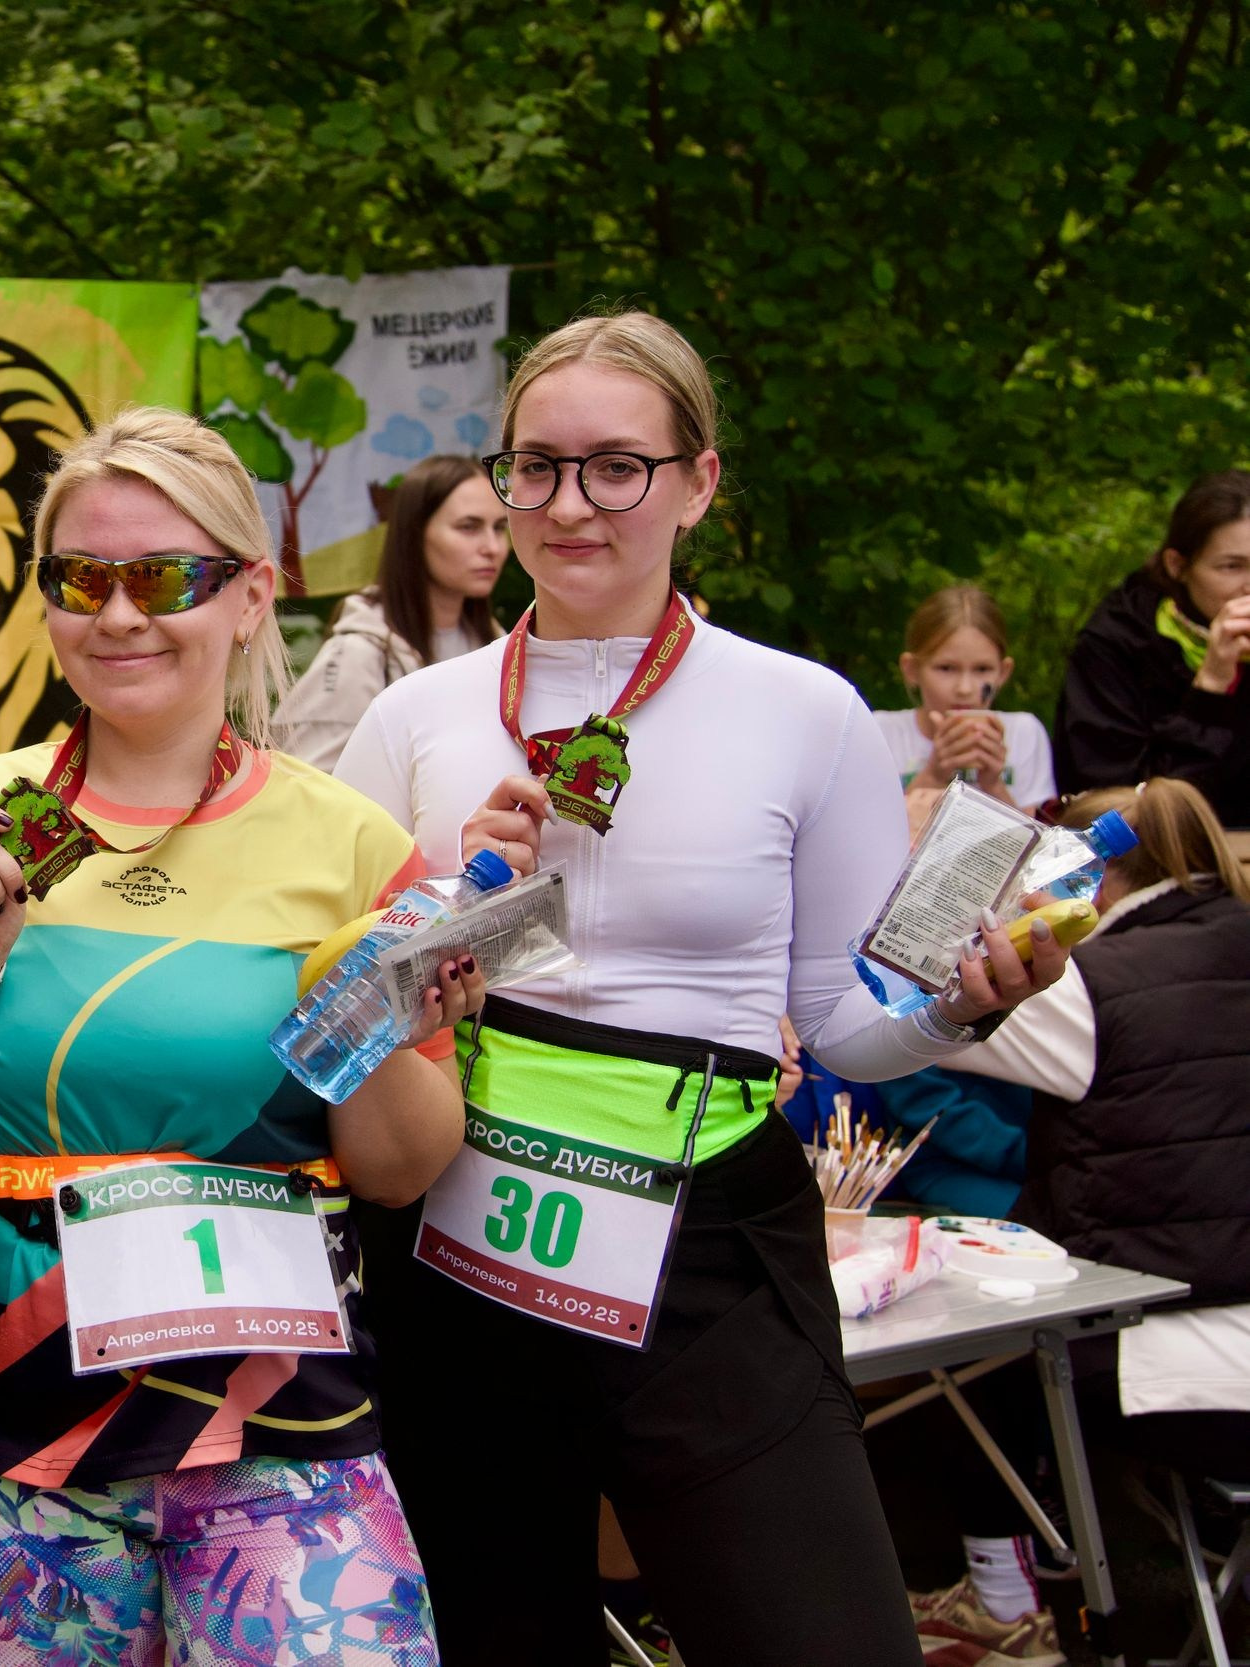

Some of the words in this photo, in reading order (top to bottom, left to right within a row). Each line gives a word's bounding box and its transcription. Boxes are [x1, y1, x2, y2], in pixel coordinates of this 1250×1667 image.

[623, 612, 689, 711] АПРЕЛЕВКА
[36, 843, 82, 887] ДУБКИ
[119, 865, 171, 884] САДОВОЕ
[101, 880, 187, 895] ЭСТАФЕТА
[119, 893, 166, 907] КОЛЬЦО
[380, 908, 426, 928] Arctic
[551, 1147, 654, 1189] ДУБКИ
[88, 1175, 194, 1210] КРОСС
[201, 1176, 291, 1204] ДУБКИ
[484, 1175, 583, 1269] 30
[183, 1218, 226, 1295] 1
[436, 1244, 517, 1293] Апрелевка
[534, 1288, 620, 1325] 14.09.25
[105, 1321, 216, 1351] Апрелевка
[236, 1319, 320, 1337] 14.09.25
